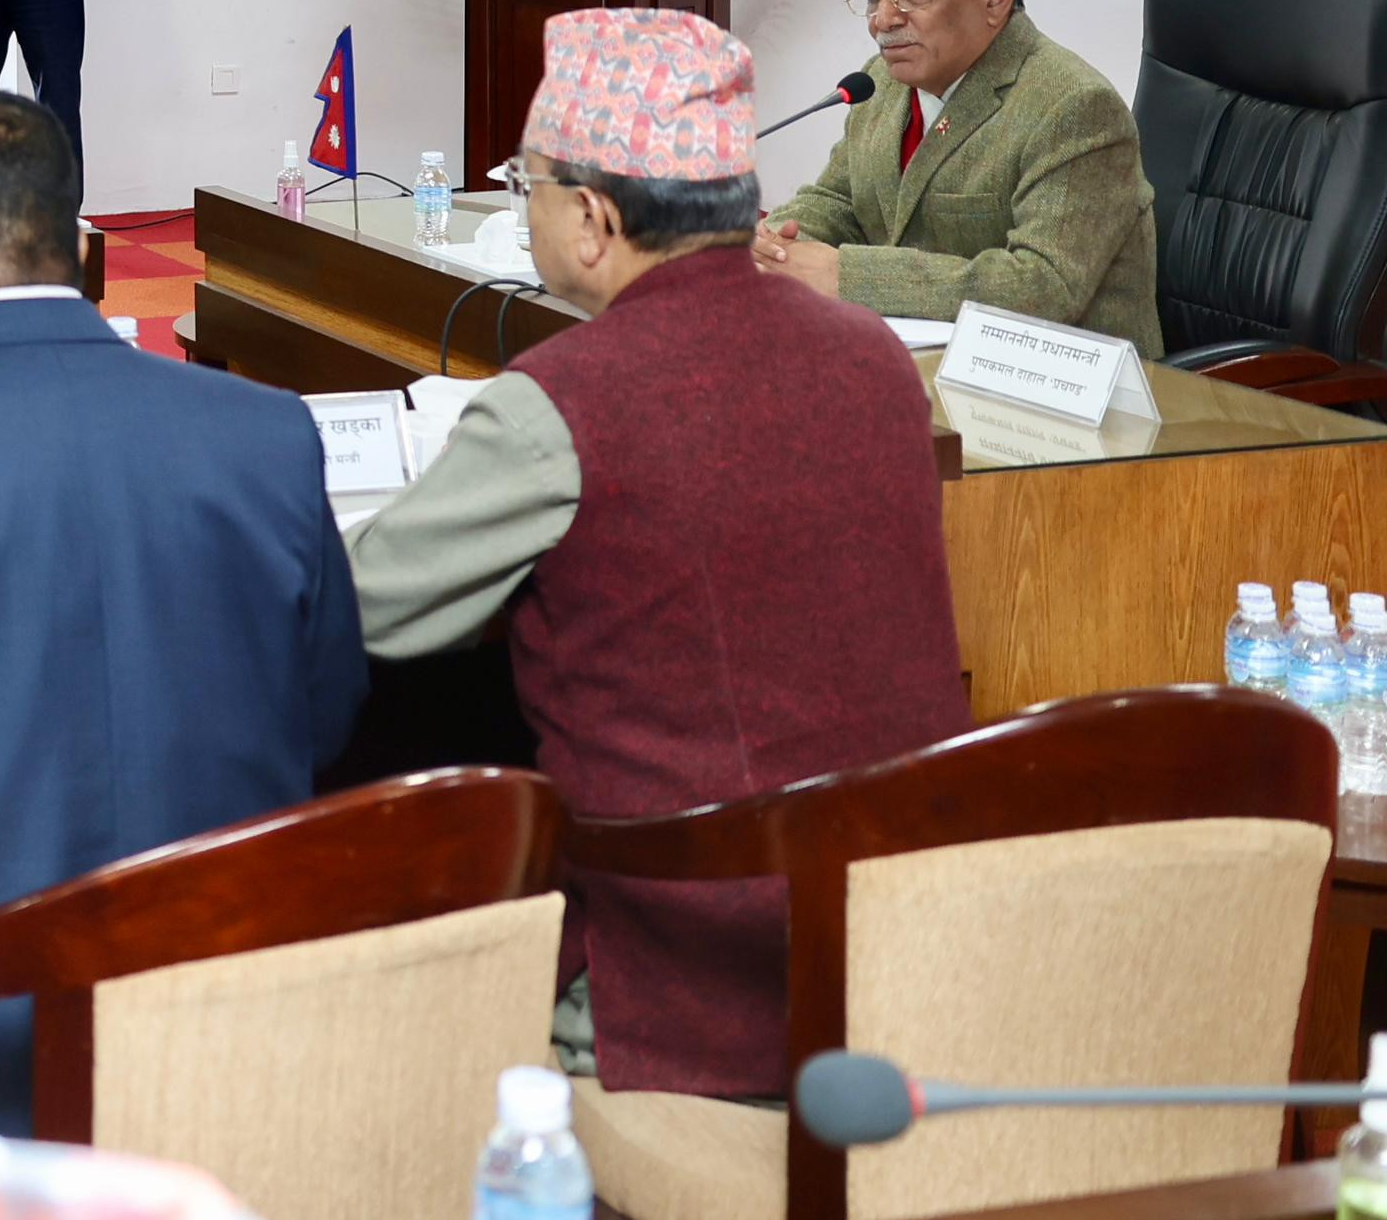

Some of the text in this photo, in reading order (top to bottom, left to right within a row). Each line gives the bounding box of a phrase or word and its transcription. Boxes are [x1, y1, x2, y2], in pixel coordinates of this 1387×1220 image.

[981, 324, 1101, 366] सम्माननीय प्रधानमन्त्री
[969, 355, 1015, 379] पुष्पकमल
[1017, 368, 1046, 386] दाहाल
[331, 417, 381, 439] खड्का
